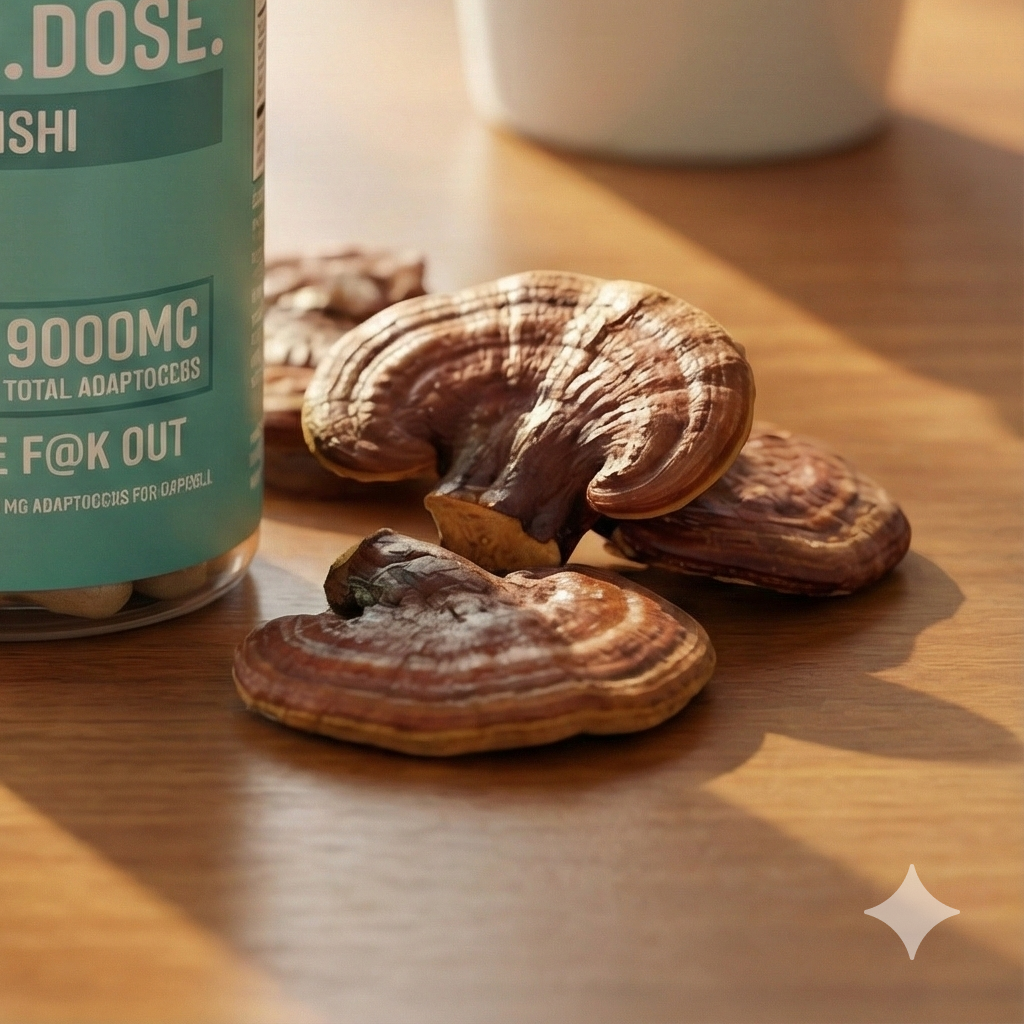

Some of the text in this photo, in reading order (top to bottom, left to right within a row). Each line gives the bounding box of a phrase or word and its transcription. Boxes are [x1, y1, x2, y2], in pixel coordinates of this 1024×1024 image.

[7, 298, 198, 368] 9000MC
[3, 378, 72, 402] TOTAL
[23, 431, 110, 476] F@K
[122, 416, 187, 467] OUT
[4, 498, 29, 514] MG
[132, 484, 157, 503] FOR
